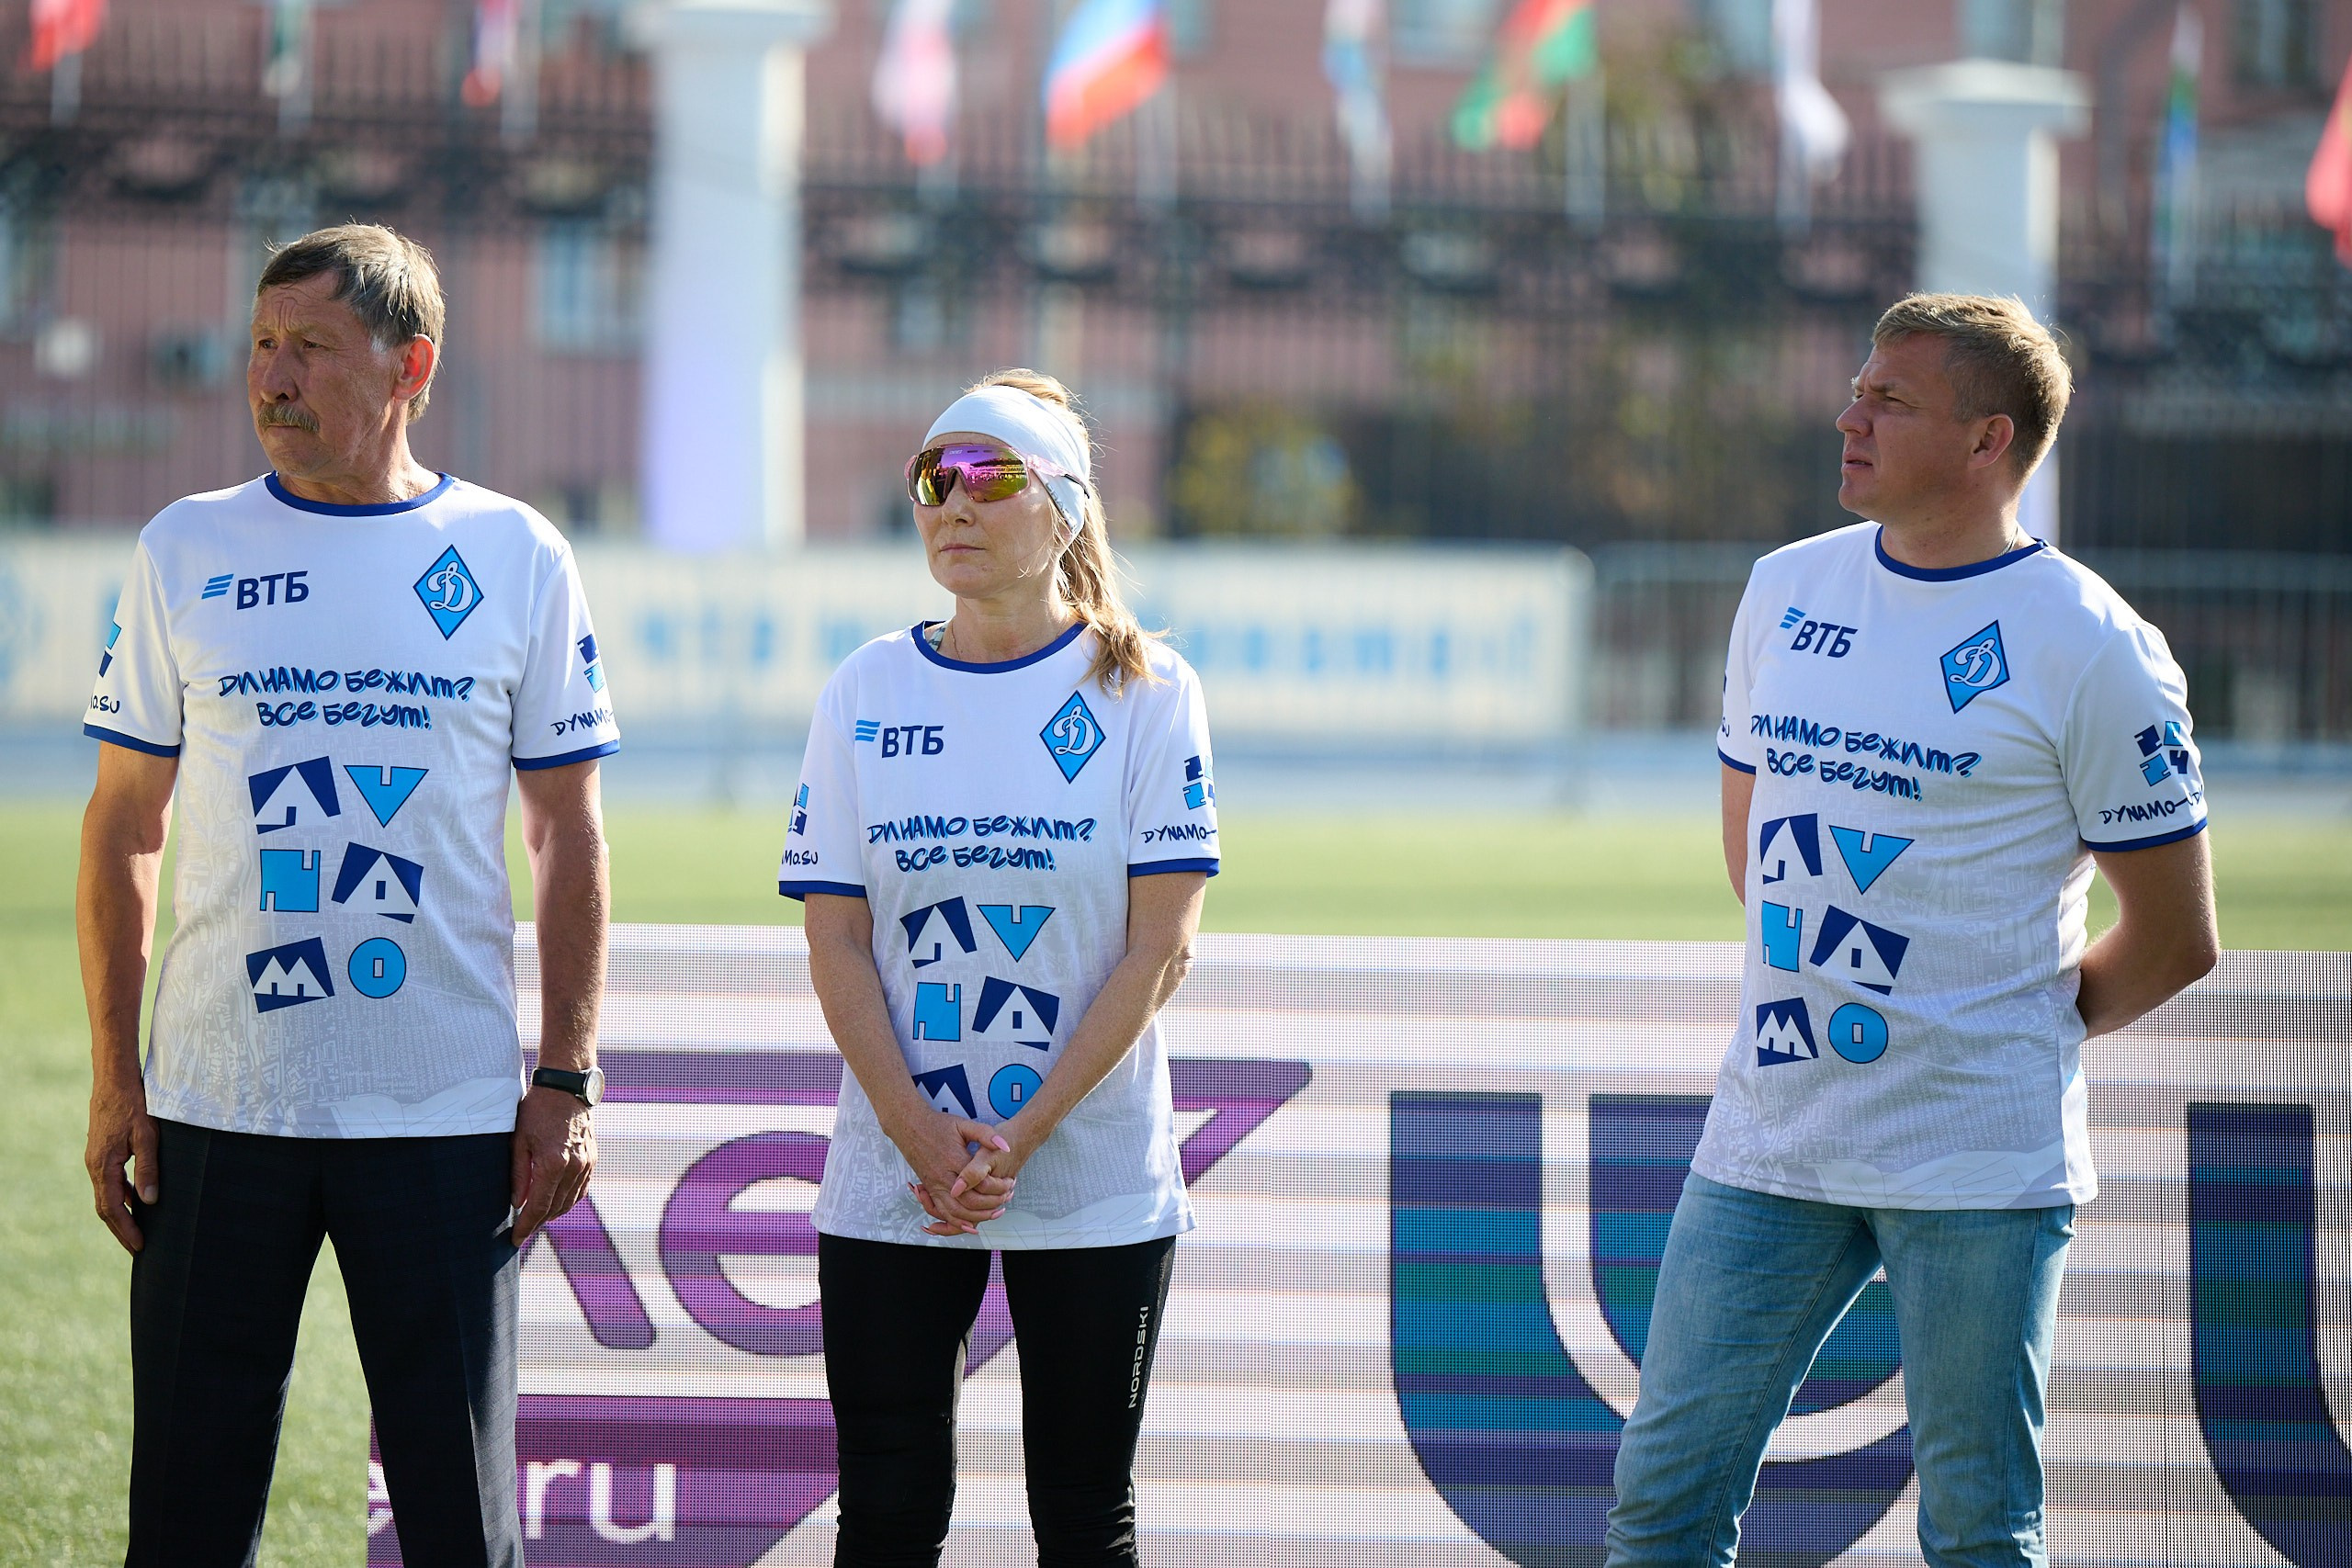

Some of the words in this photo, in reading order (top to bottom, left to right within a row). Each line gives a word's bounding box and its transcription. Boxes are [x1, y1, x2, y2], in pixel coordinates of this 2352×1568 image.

[236, 570, 310, 611] ВТБ
[1790, 619, 1859, 659] ВТБ
[218, 666, 341, 697] ДИНАМО
[881, 725, 944, 759] ВТБ
[866, 815, 968, 844] ДИНАМО
[1127, 1305, 1149, 1409] NORDSKI
